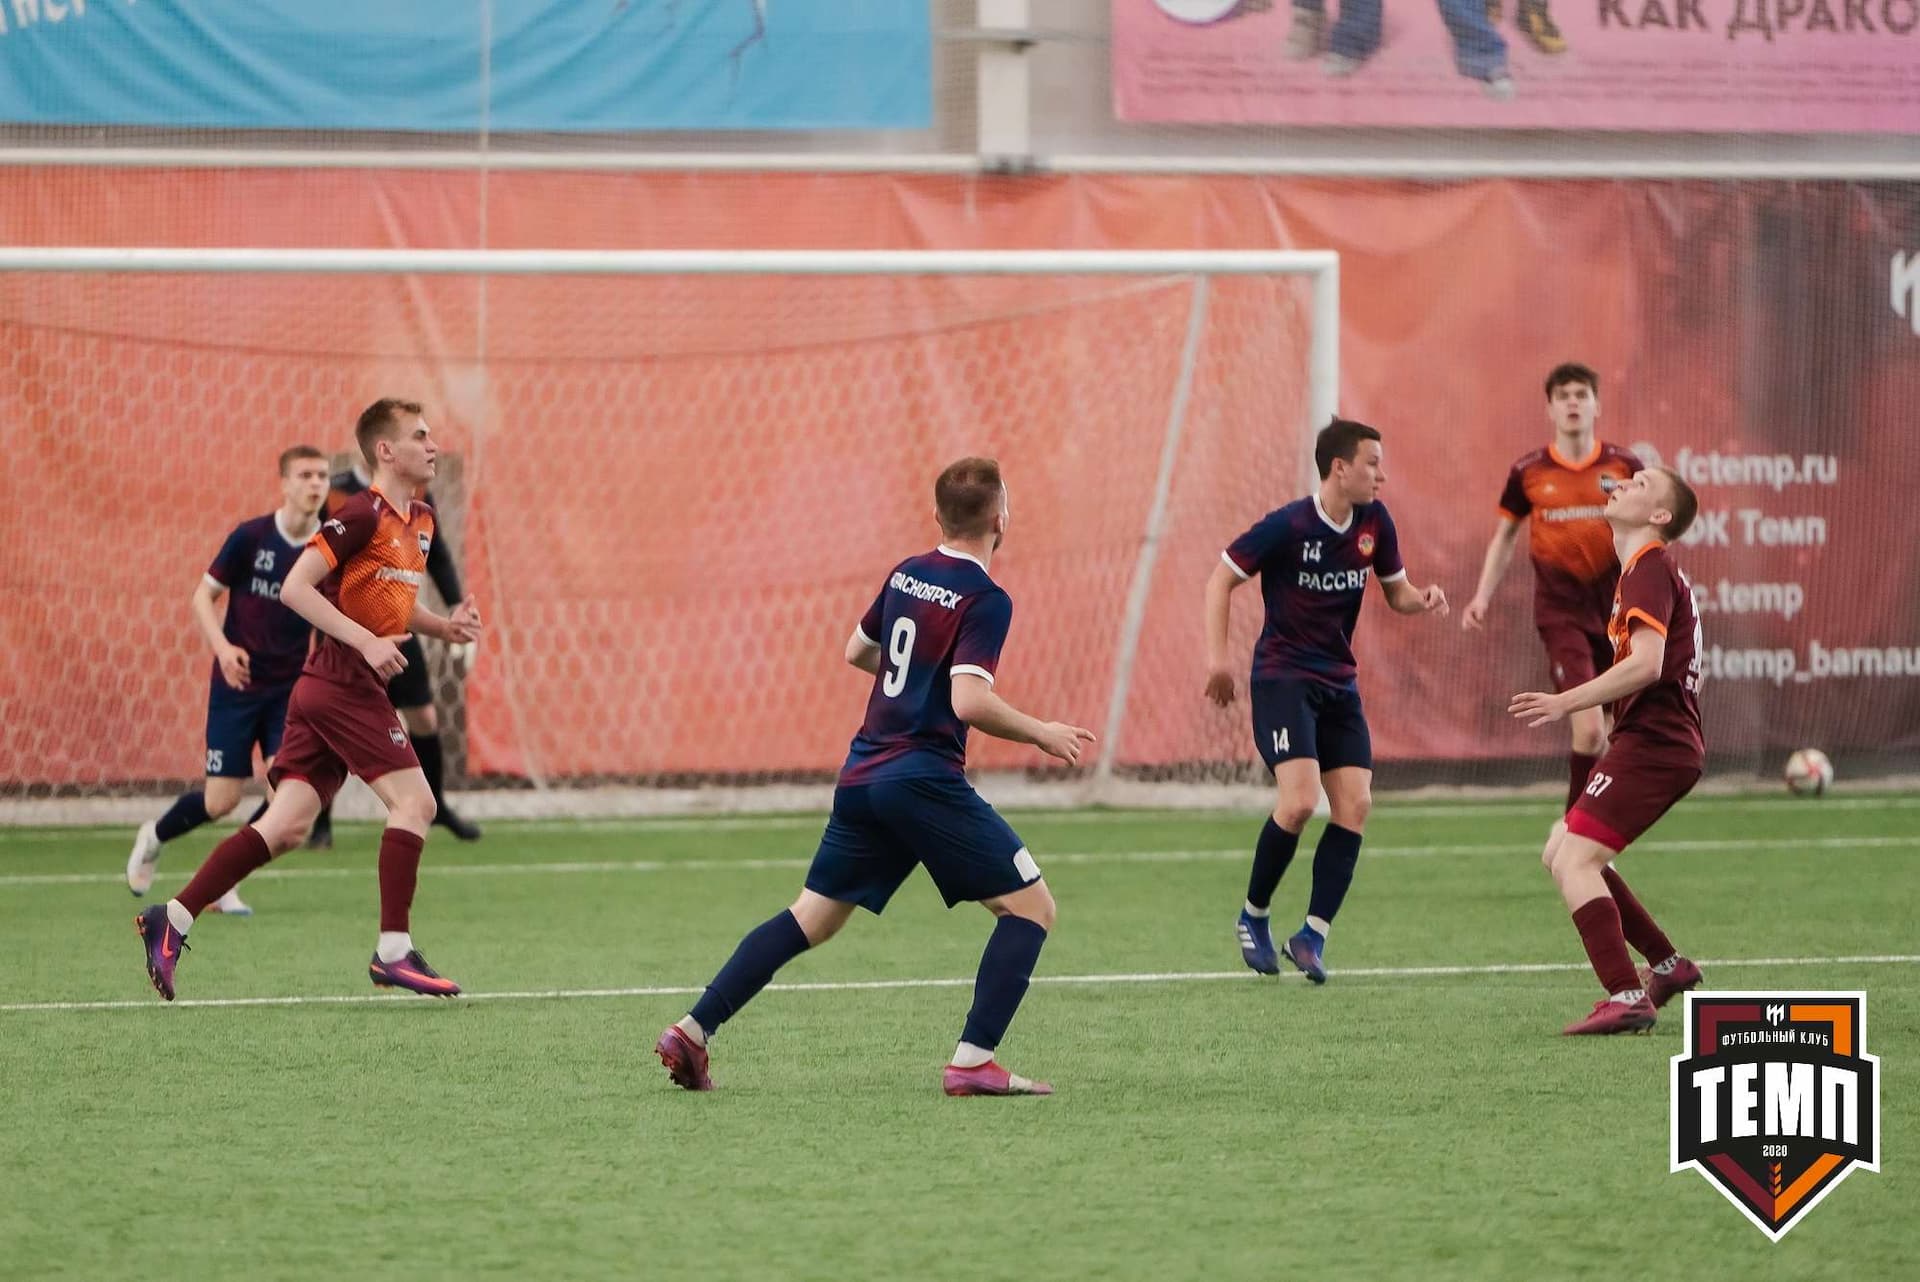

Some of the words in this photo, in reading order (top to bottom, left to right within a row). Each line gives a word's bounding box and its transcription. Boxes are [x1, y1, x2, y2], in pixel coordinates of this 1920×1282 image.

[1599, 0, 1708, 30] КАК
[1678, 449, 1838, 492] fctemp.ru
[1738, 510, 1827, 545] Темп
[254, 549, 276, 571] 25
[1302, 541, 1322, 562] 14
[1298, 566, 1371, 591] РАССВЕ
[1694, 578, 1804, 621] c.temp
[883, 616, 916, 698] 9
[1272, 727, 1290, 755] 14
[1586, 772, 1613, 797] 27
